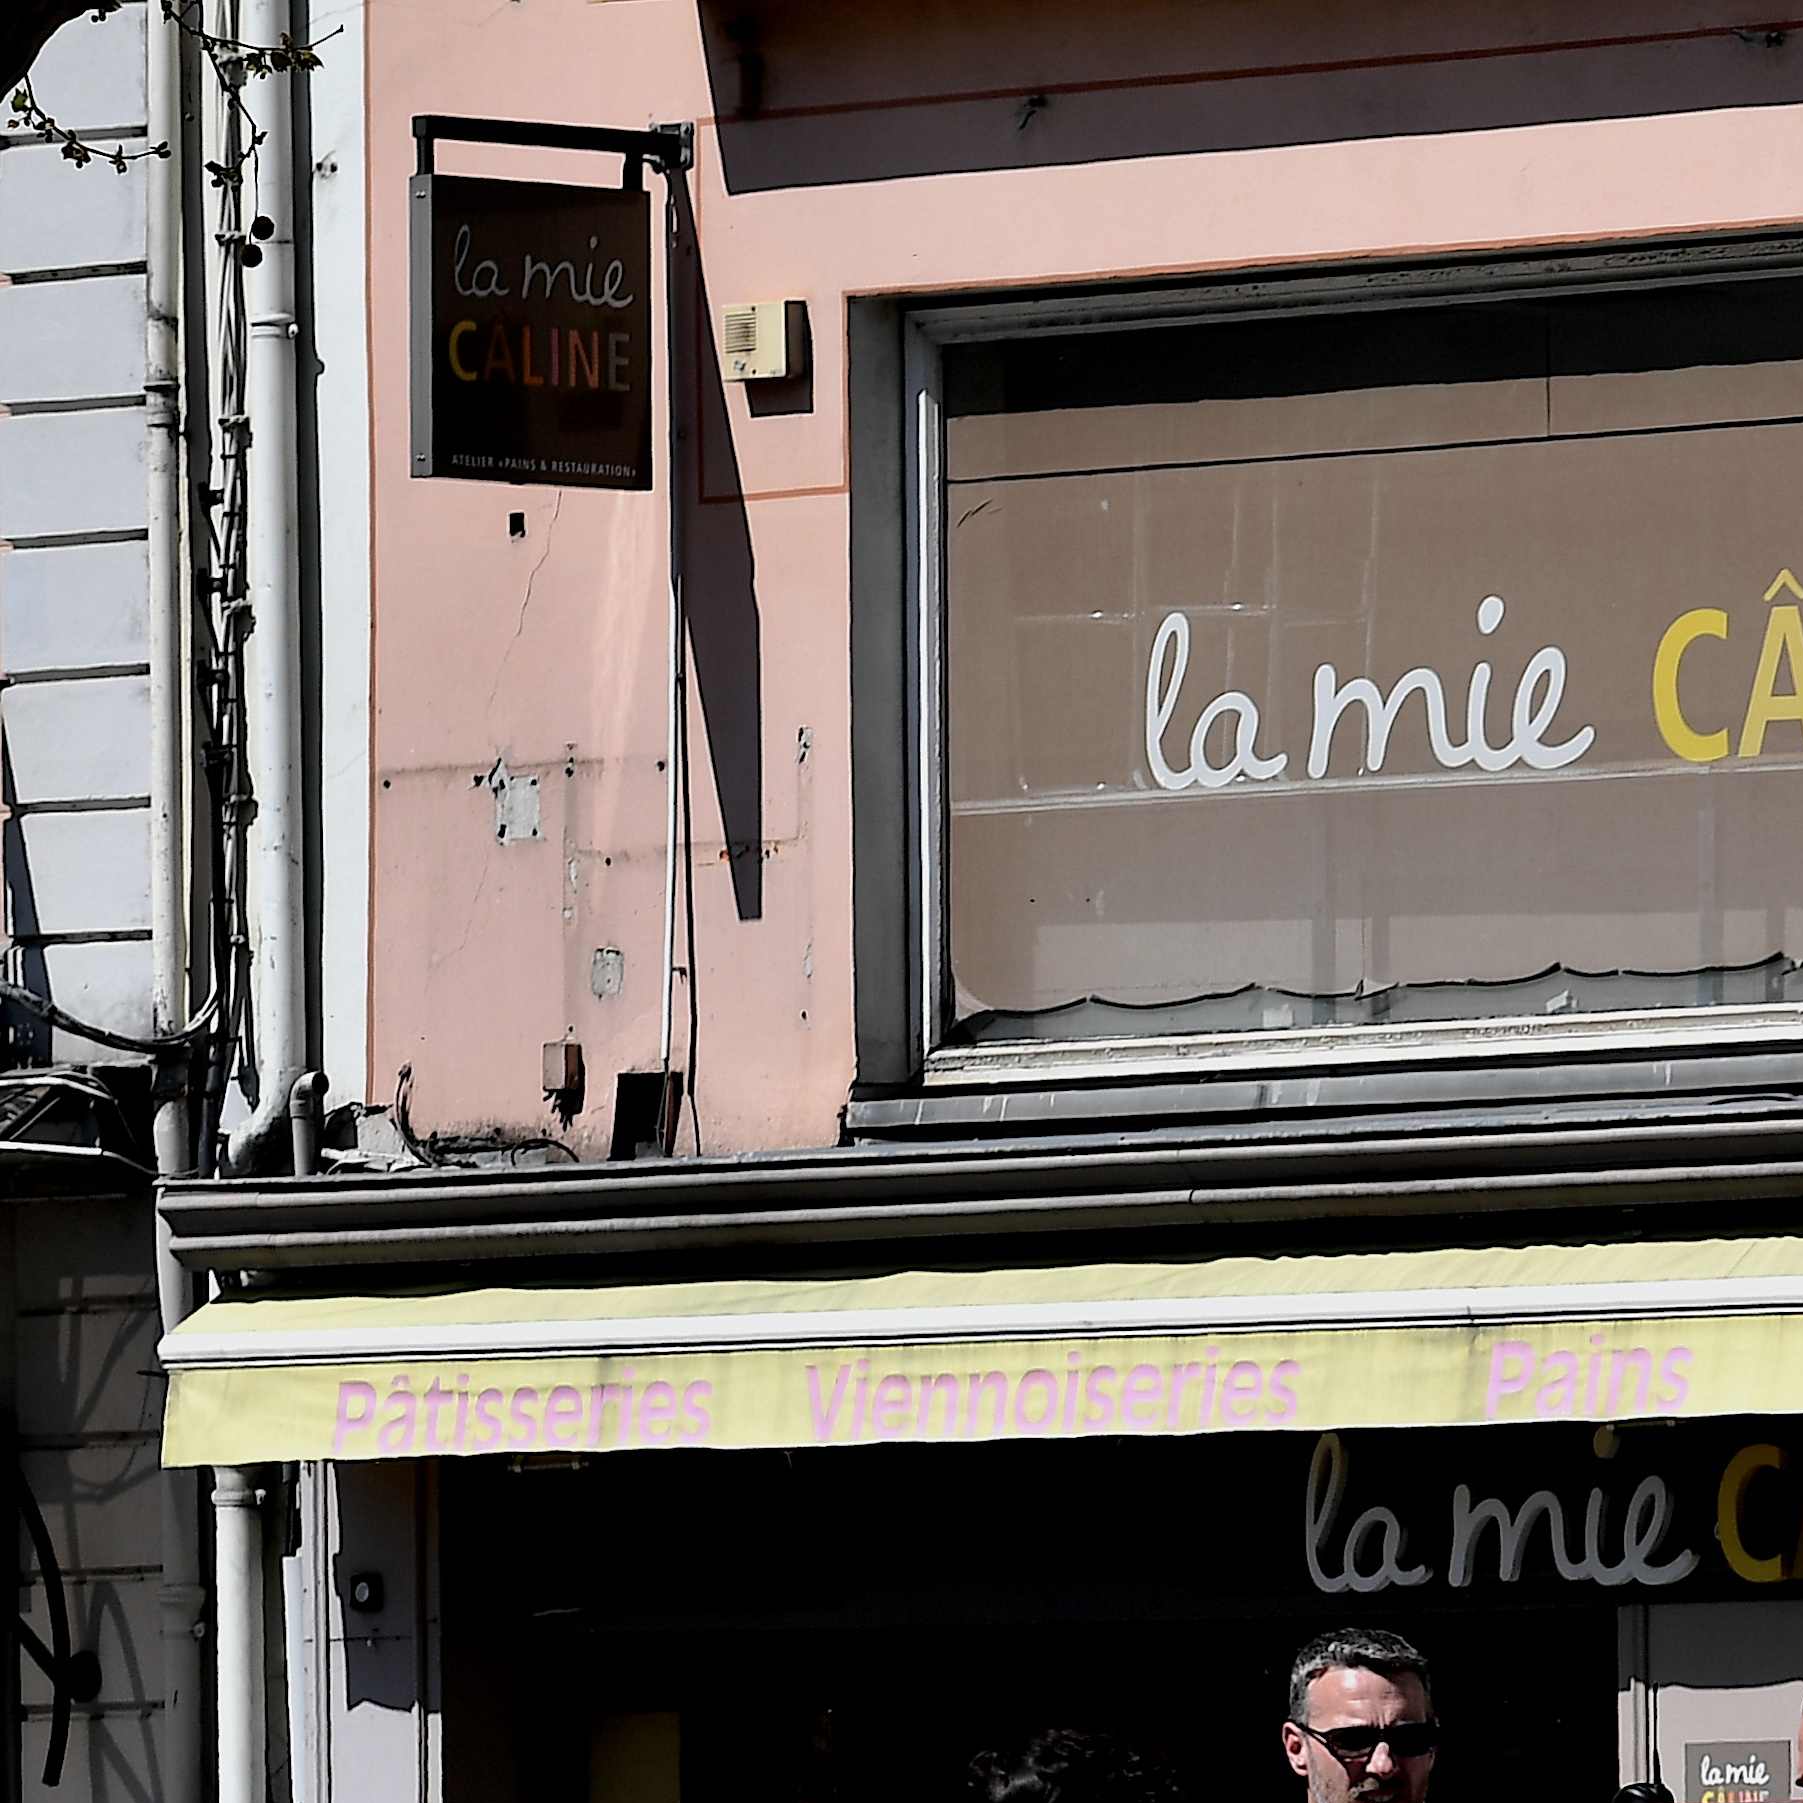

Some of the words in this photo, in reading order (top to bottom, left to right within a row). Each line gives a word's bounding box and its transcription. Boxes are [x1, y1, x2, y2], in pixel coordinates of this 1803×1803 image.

[454, 223, 510, 298] la
[522, 235, 633, 309] mie
[451, 454, 494, 468] ATELIER
[1146, 611, 1289, 790] la
[1306, 594, 1597, 779] mie
[331, 1367, 714, 1456] Pâtisseries
[804, 1346, 1302, 1443] Viennoiseries
[1485, 1332, 1695, 1421] Pains
[1305, 1432, 1434, 1593] la
[1447, 1427, 1701, 1587] mie
